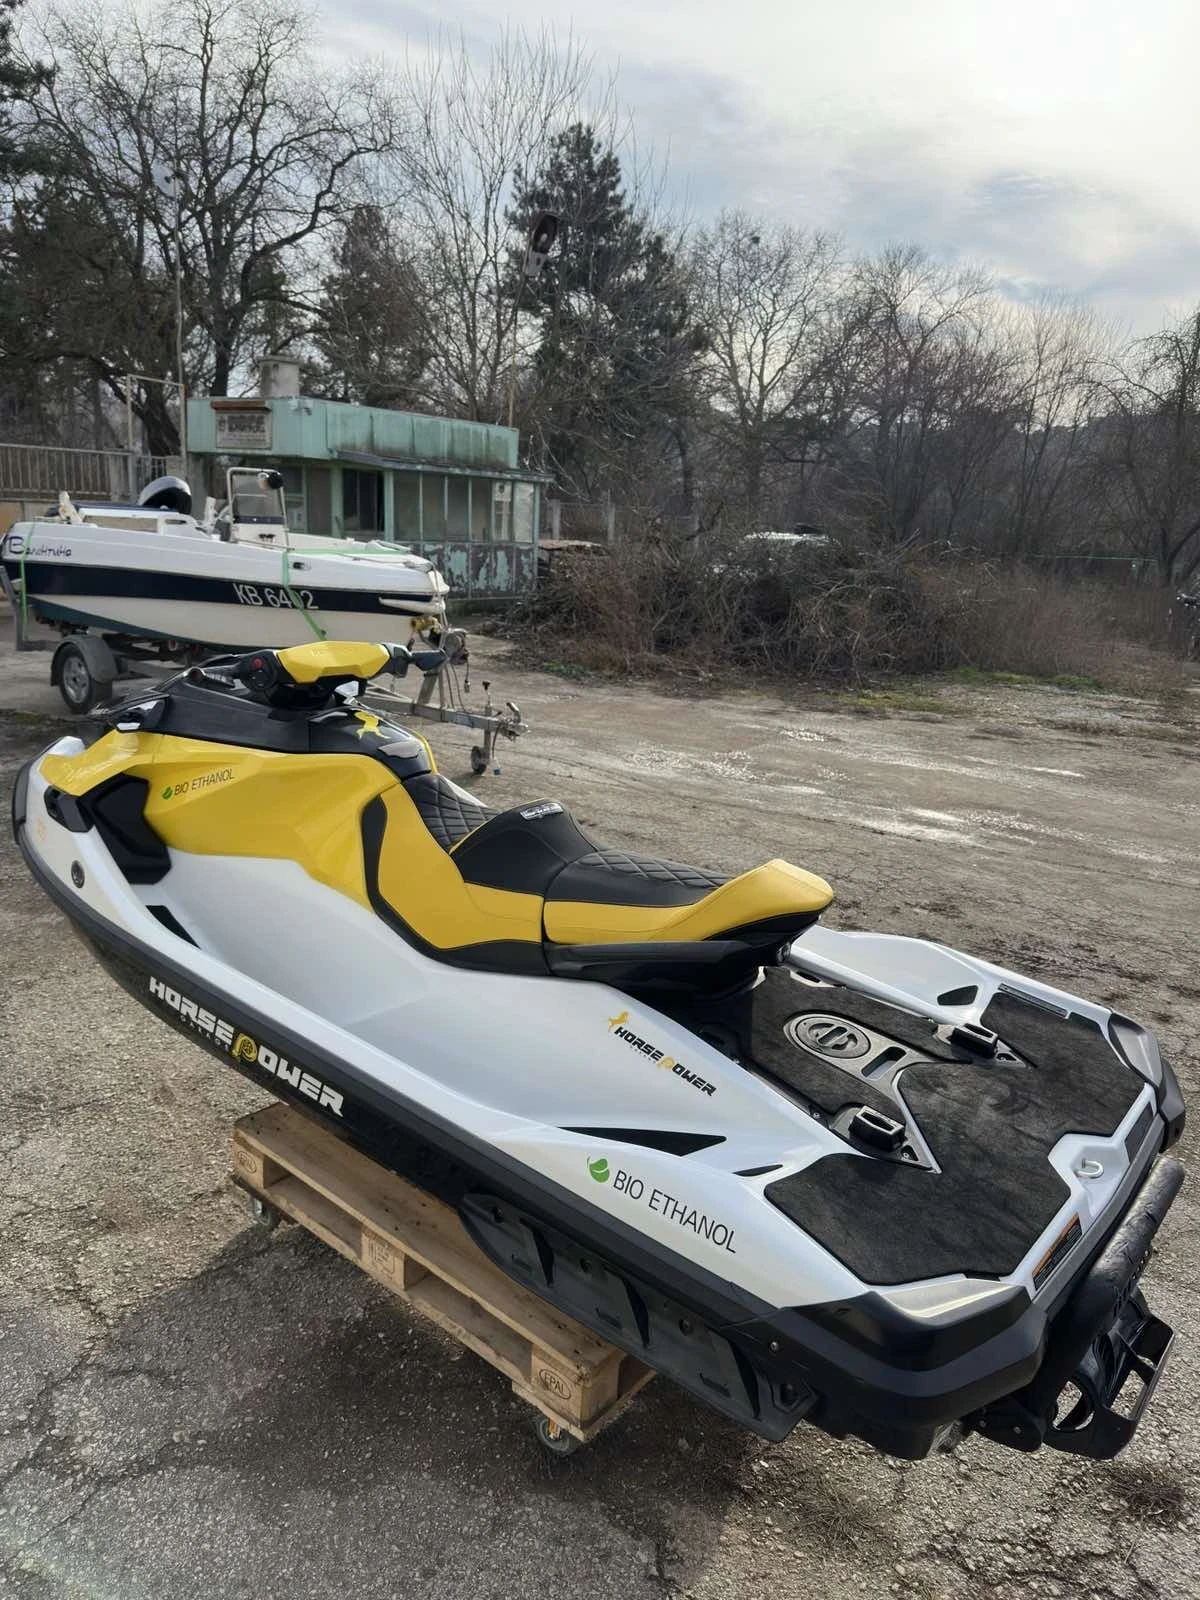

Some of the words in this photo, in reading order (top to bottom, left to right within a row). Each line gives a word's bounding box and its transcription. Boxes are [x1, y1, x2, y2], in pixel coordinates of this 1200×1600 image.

[232, 583, 263, 605] KB
[174, 782, 189, 796] BIO
[191, 768, 235, 791] ETHANOL
[613, 1169, 645, 1200] BIO
[648, 1188, 737, 1254] ETHANOL
